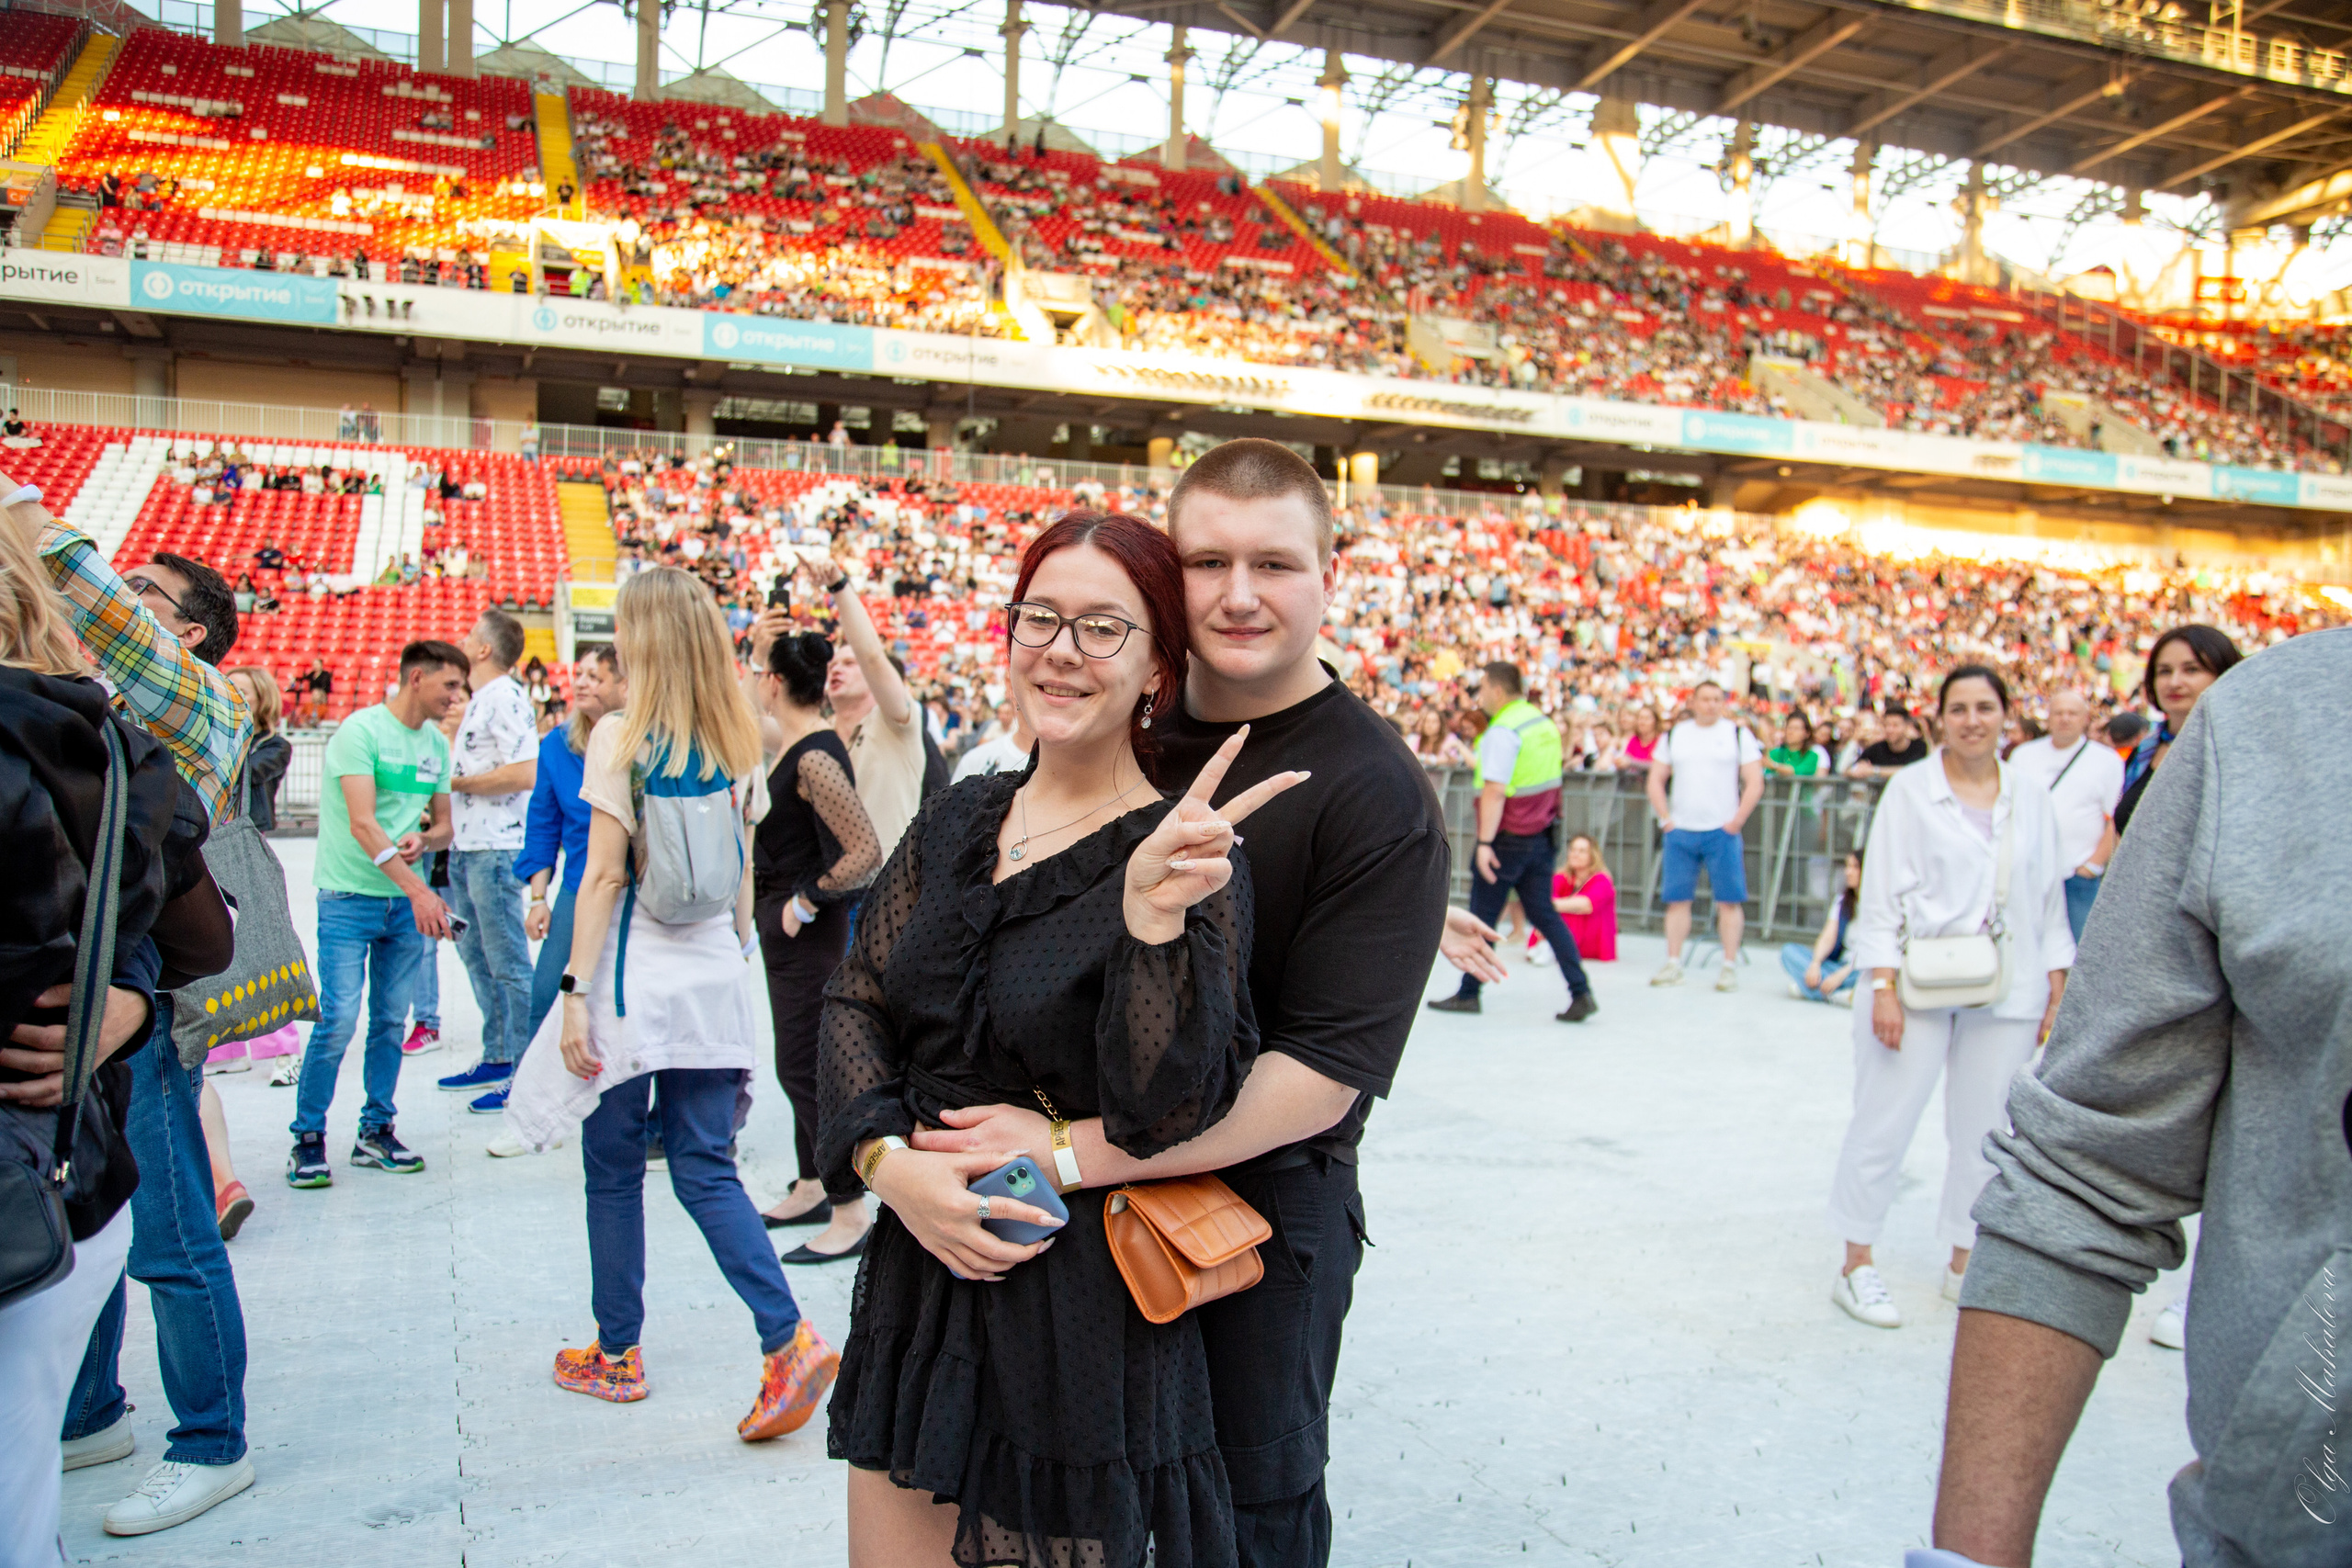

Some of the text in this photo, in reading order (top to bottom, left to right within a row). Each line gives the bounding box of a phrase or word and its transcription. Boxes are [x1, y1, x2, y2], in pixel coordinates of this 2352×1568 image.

[178, 279, 291, 304] открытие
[563, 314, 662, 335] открытие
[741, 330, 835, 353] открытие
[912, 347, 1000, 367] открытие
